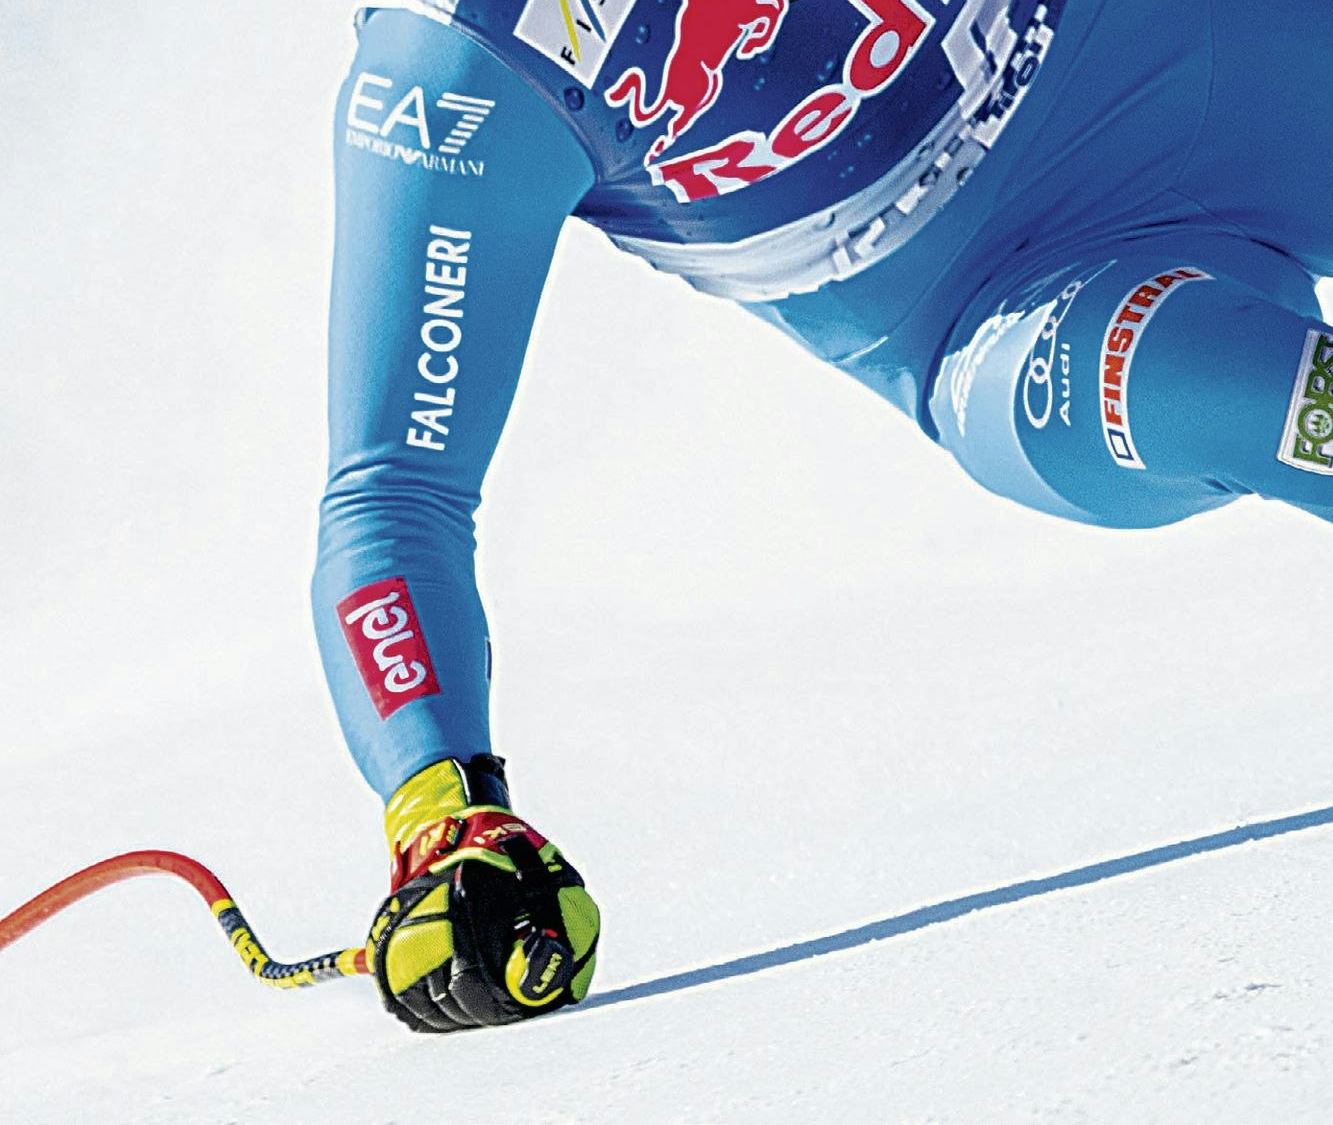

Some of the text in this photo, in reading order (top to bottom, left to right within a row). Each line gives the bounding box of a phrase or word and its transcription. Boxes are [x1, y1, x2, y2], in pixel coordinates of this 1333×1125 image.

[347, 72, 496, 155] EA7
[406, 224, 472, 451] FALCONERI
[1059, 343, 1071, 427] Audi
[345, 591, 426, 695] enel
[532, 952, 563, 994] LEKI
